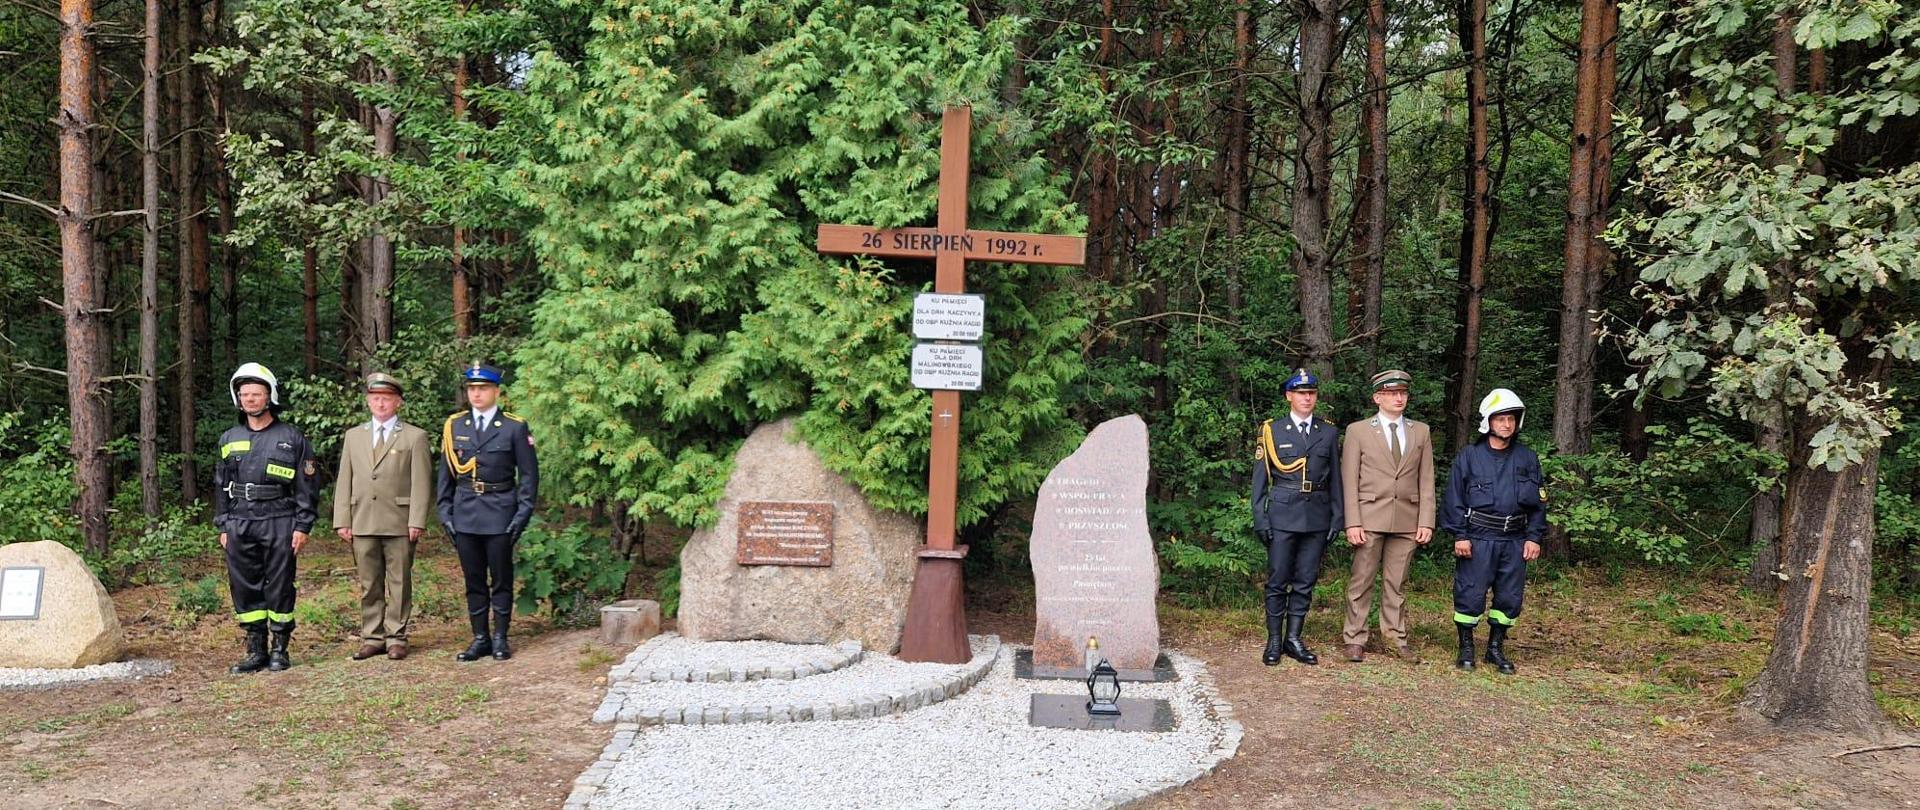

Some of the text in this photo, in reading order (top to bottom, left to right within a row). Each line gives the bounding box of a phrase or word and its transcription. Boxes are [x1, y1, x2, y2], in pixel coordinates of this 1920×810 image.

[862, 232, 1043, 256] 26 SIERPIEŃ 1992 r.
